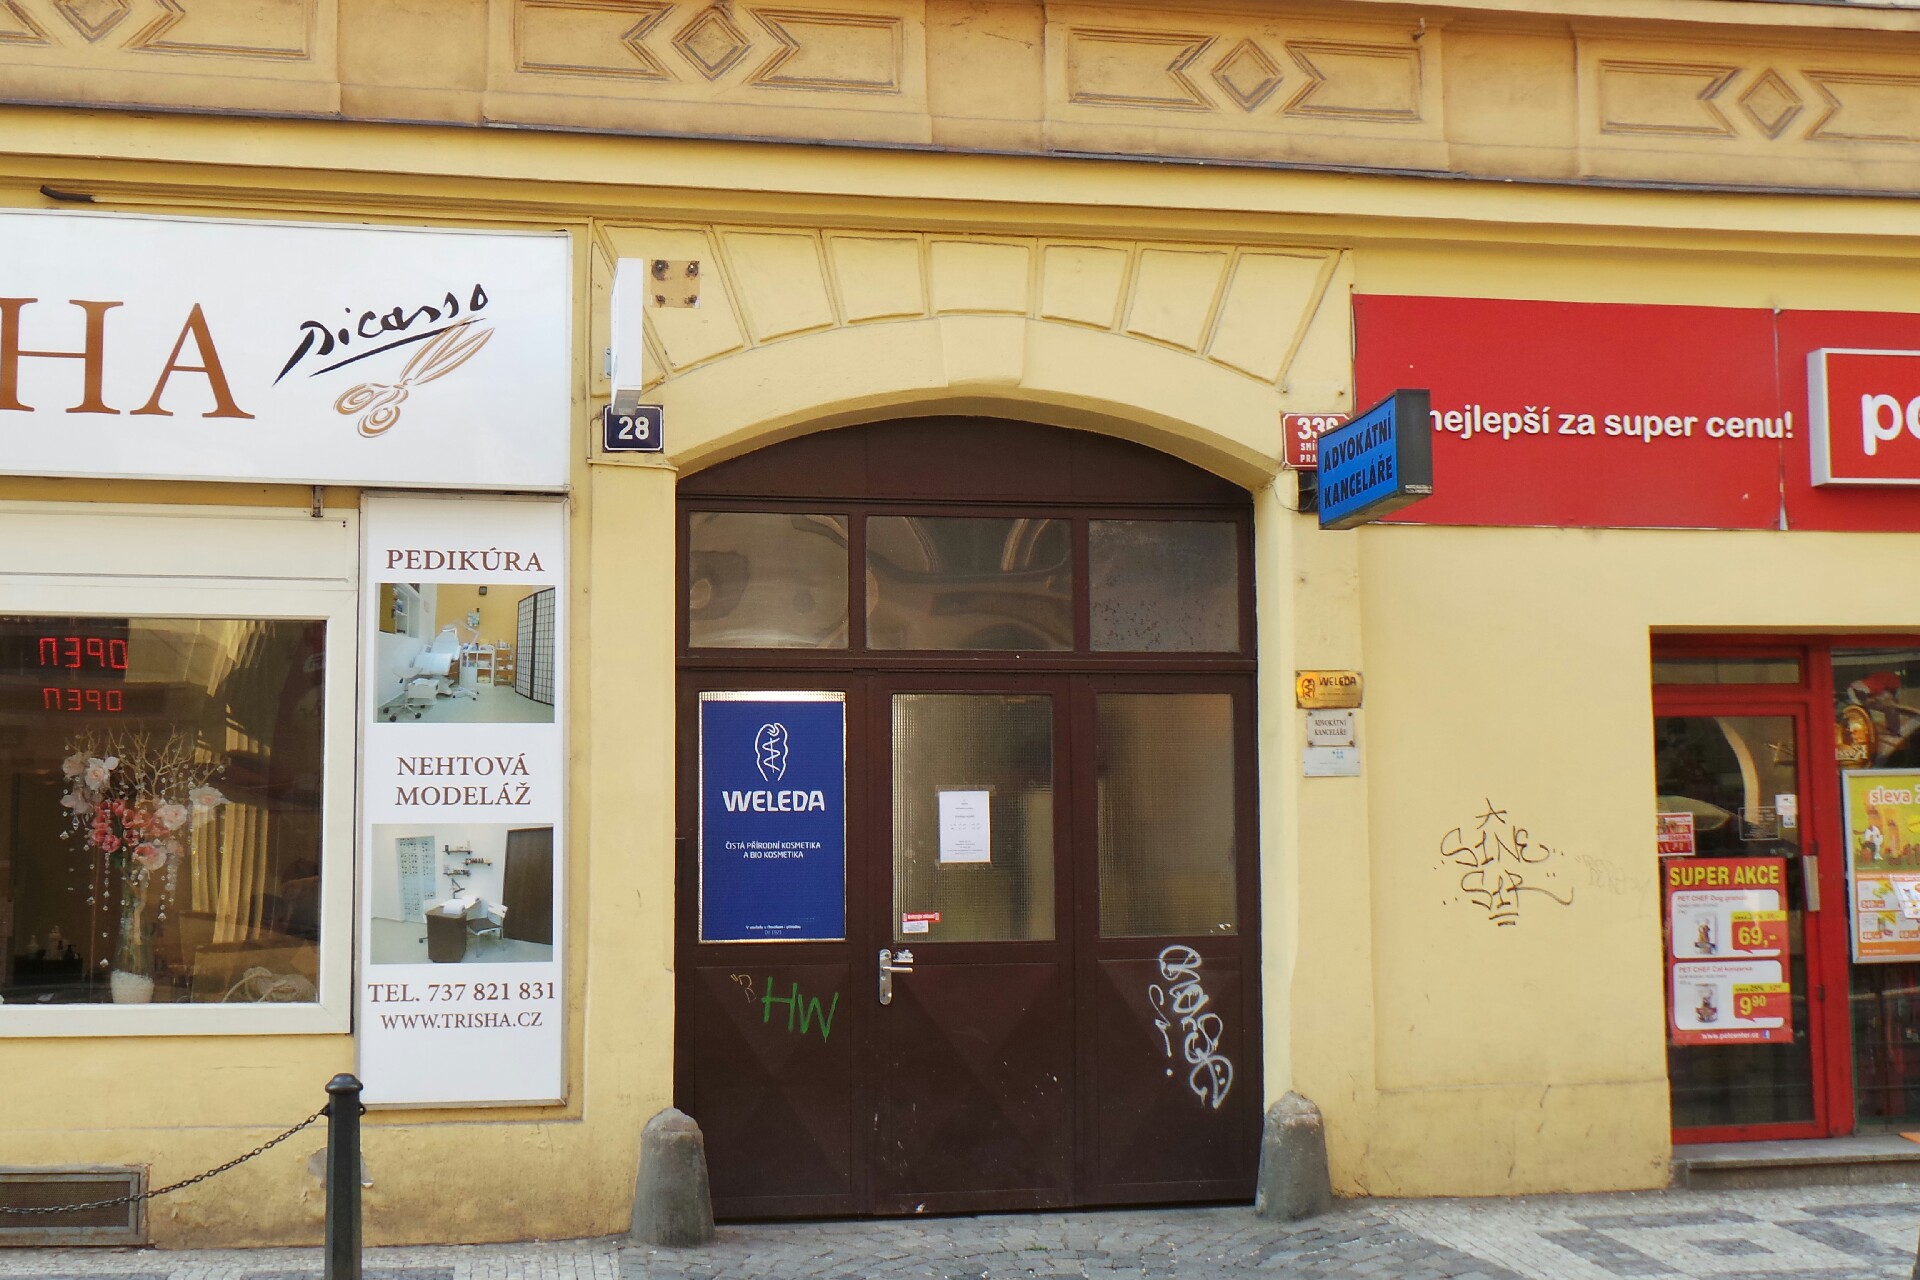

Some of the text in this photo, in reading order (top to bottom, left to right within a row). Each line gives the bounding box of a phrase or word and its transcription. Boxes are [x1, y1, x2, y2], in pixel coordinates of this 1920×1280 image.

[618, 416, 650, 440] 28
[1429, 404, 1794, 443] nejlepší za super cenu!
[1323, 410, 1392, 474] ADVOKÁTNÍ
[1300, 454, 1317, 463] PRA
[1324, 455, 1393, 510] KANCELÁŘE
[385, 547, 545, 572] PEDIKÚRA
[1319, 676, 1356, 686] WELEDA
[397, 752, 530, 776] NEHTOVÁ
[395, 782, 531, 806] MODELÁŽ
[722, 790, 825, 812] WELEDA
[1870, 786, 1911, 803] sleva
[725, 840, 821, 850] ČISTÁ PŘÍRODNÍ KOSMETIKA
[743, 851, 804, 859] A BIO KOSMETIKA
[1669, 865, 1780, 886] SUPER AKCE
[368, 982, 556, 1003] TEL. 737 821 831
[381, 1011, 543, 1030] WWW.TRISHA.CZ
[761, 976, 839, 1043] HW
